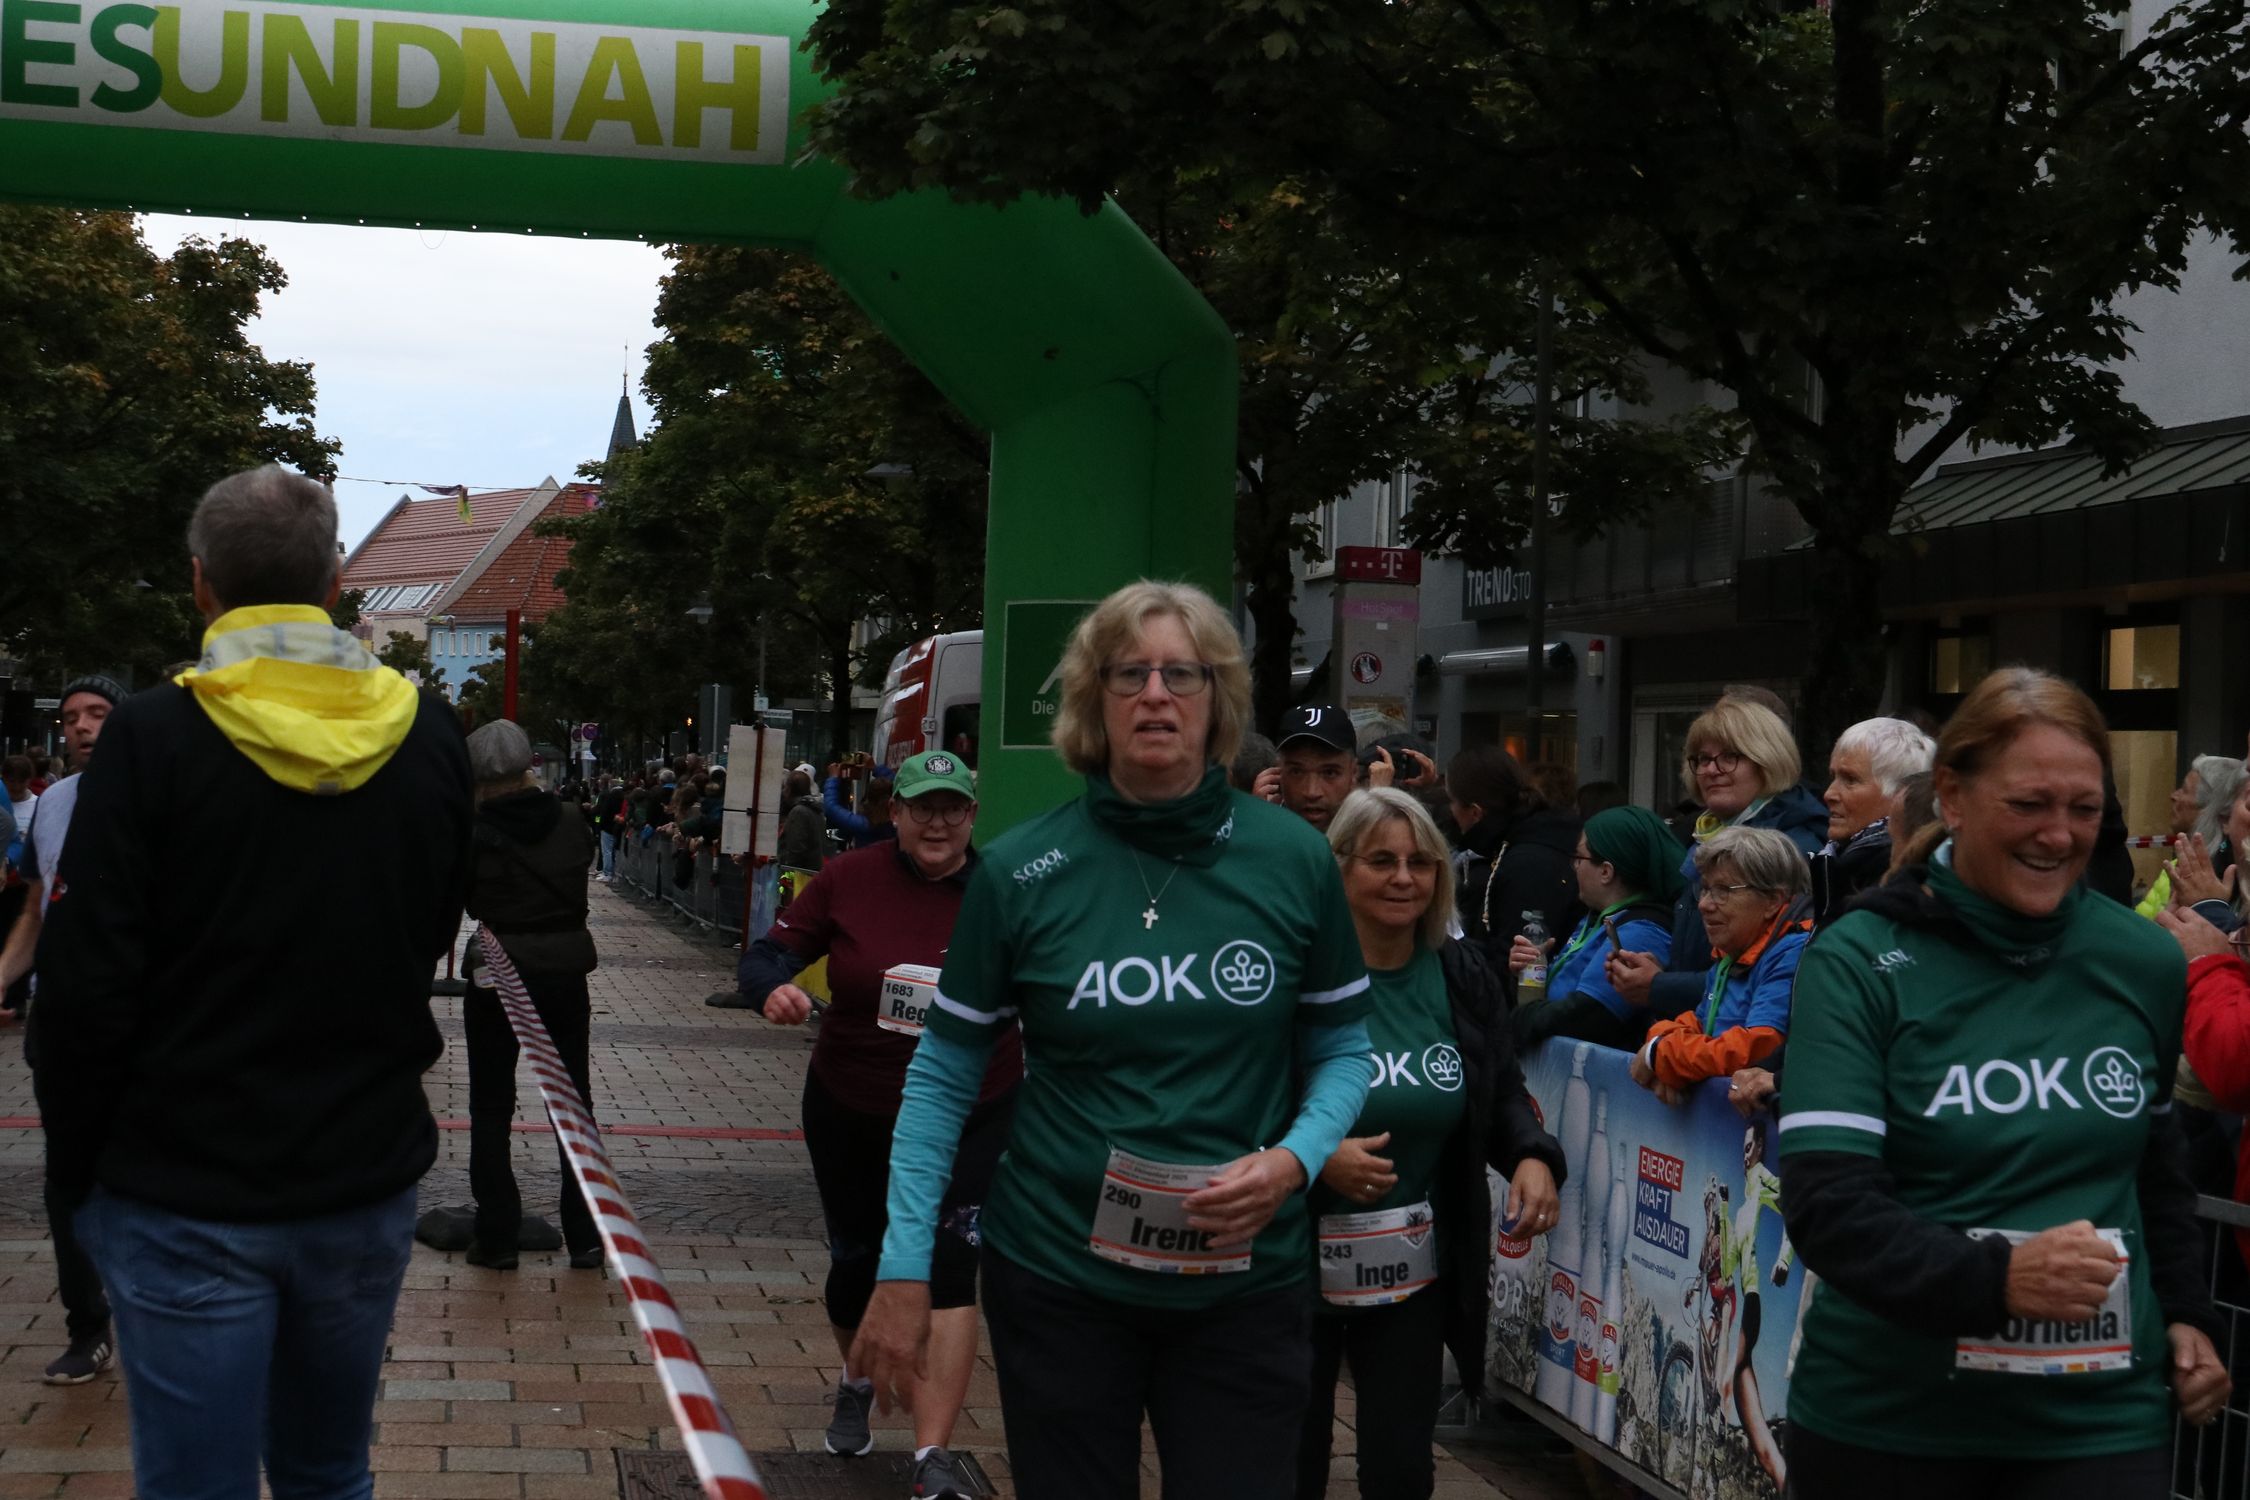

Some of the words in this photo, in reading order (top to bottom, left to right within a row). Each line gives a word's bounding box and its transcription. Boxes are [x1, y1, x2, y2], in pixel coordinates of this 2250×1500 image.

[0, 3, 761, 152] ESUNDNAH
[1032, 700, 1055, 715] Die
[885, 983, 914, 997] 1683
[1066, 953, 1206, 1010] AOK
[891, 998, 927, 1026] Reg
[1922, 1057, 2084, 1116] AOK
[1641, 1150, 1681, 1187] ENERGIE
[1104, 1185, 1141, 1209] 290
[1638, 1180, 1670, 1213] KRAFT
[1636, 1212, 1685, 1253] AUSDAUER
[1323, 1244, 1352, 1259] 243
[1356, 1261, 1409, 1289] Inge
[1976, 1311, 2118, 1343] ornelia
